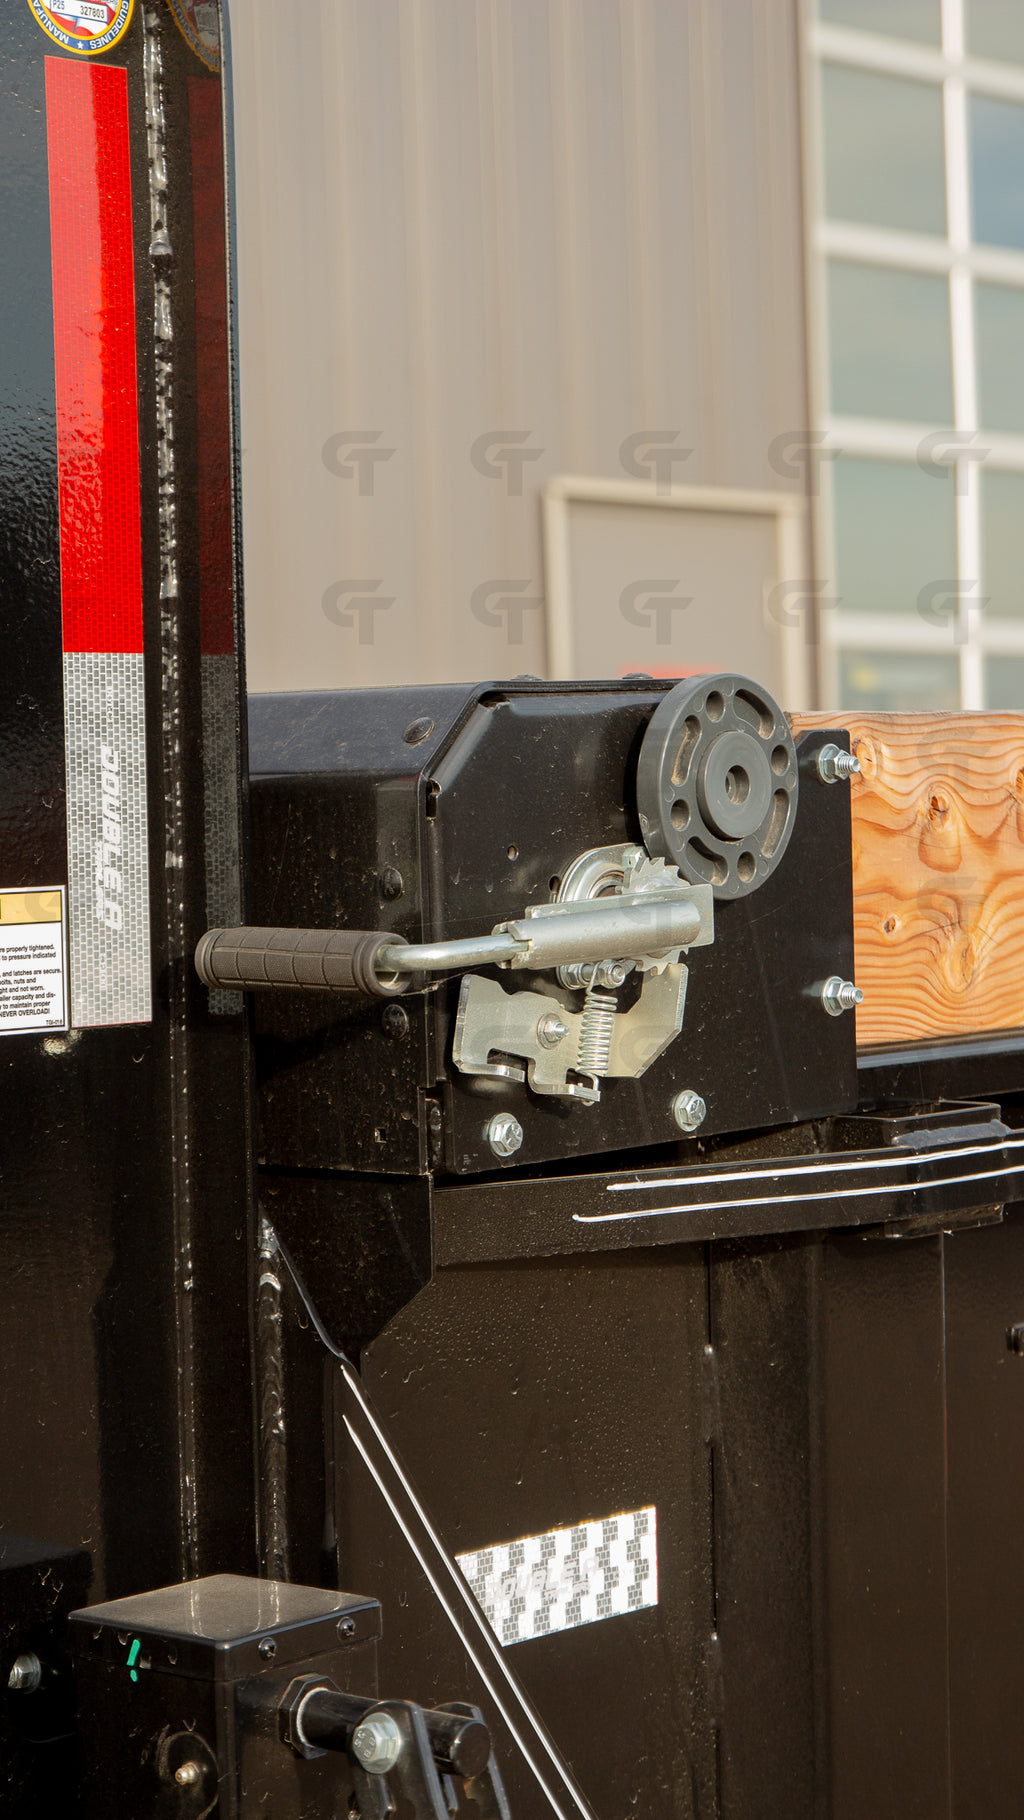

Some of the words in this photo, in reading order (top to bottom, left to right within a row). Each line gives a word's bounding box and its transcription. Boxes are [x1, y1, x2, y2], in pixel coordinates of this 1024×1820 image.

[80, 5, 105, 19] 327803
[89, 1, 129, 49] GUIDELINES
[101, 744, 122, 893] DOUBLE
[104, 900, 122, 931] A
[6, 945, 28, 953] properly
[29, 944, 55, 952] tightened.
[8, 953, 31, 962] pressure
[12, 993, 34, 1002] capacity
[33, 1001, 51, 1009] proper
